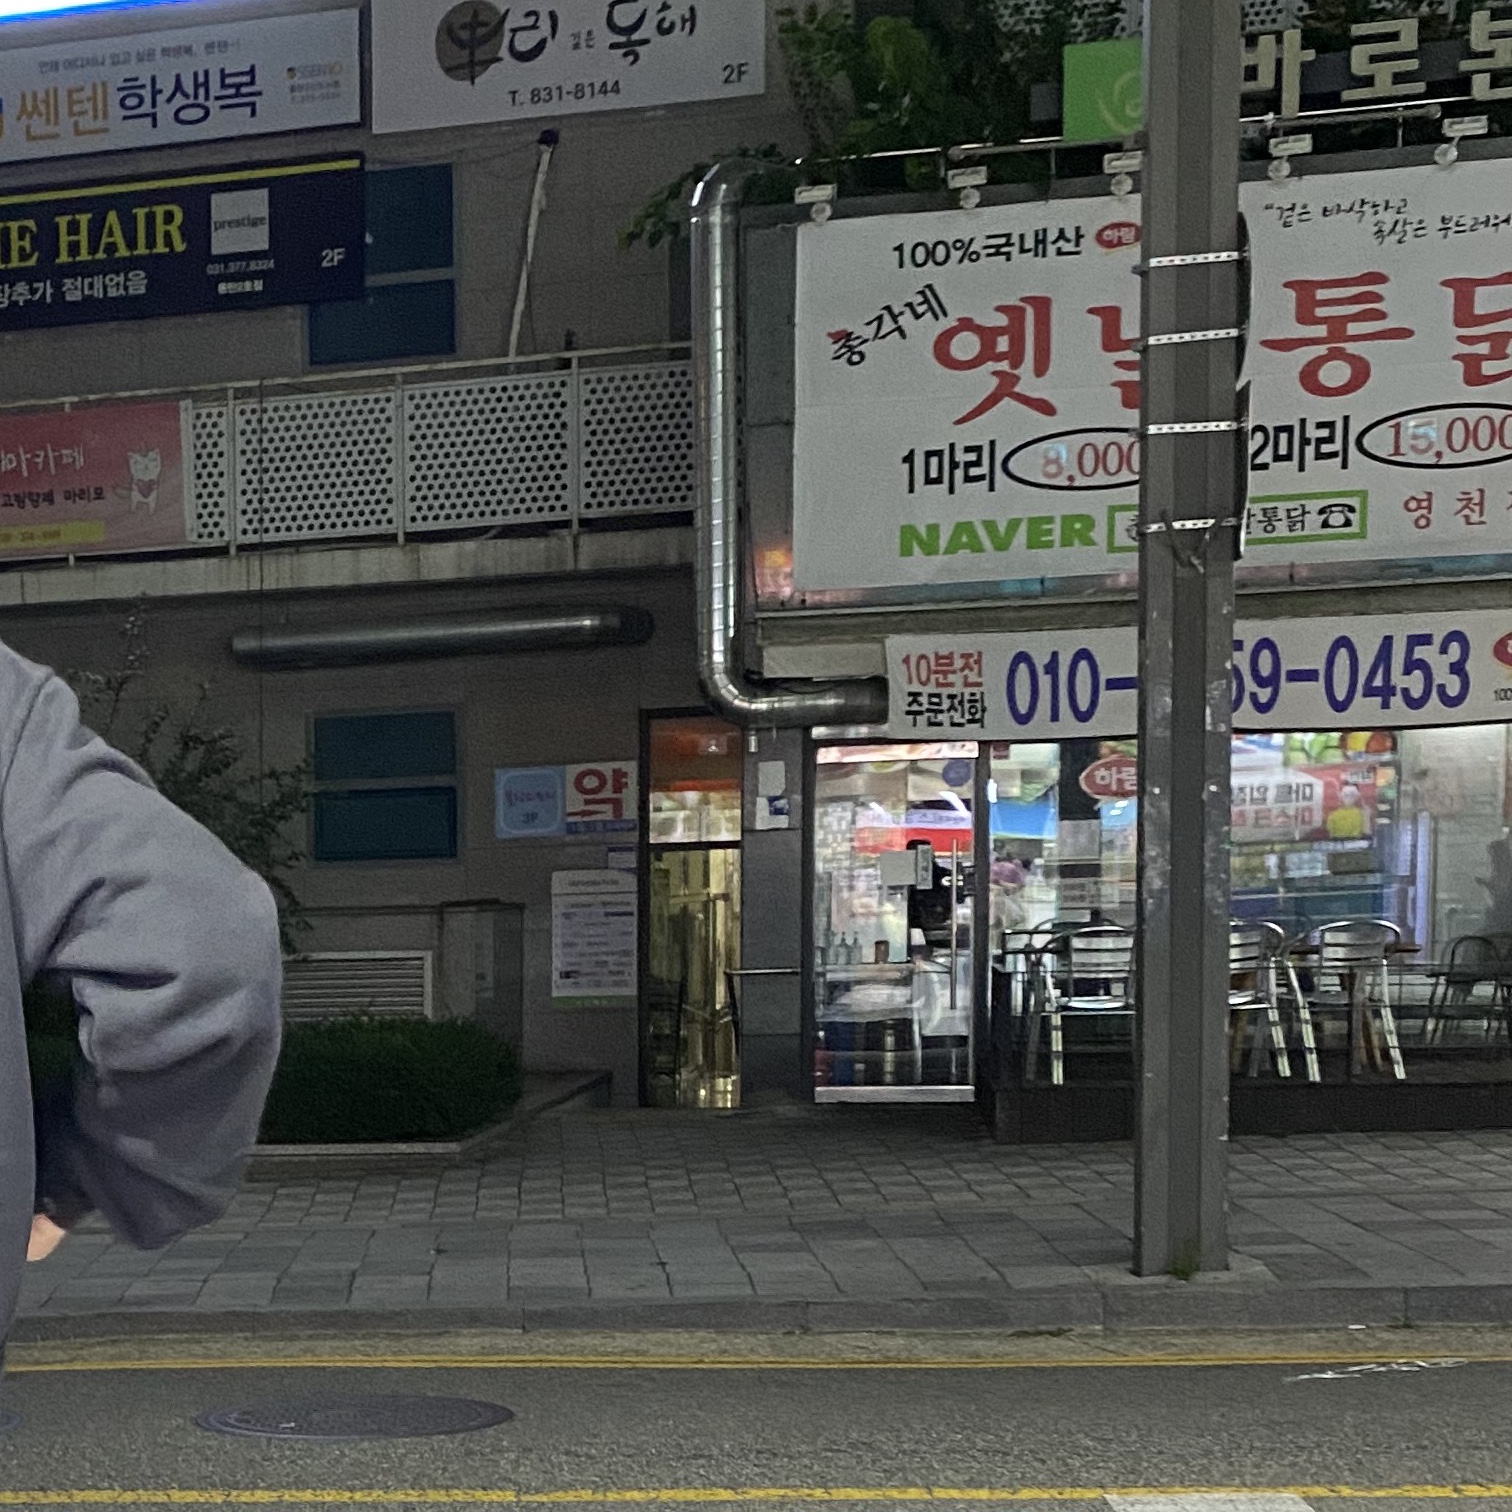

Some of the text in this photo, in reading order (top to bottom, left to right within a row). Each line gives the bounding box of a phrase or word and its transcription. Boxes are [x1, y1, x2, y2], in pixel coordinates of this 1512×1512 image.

[530, 80, 621, 106] 831-8144
[723, 62, 750, 85] 2F
[55, 203, 187, 264] HAIR
[213, 213, 267, 232] prestige
[321, 247, 346, 268] 2F
[892, 225, 1085, 269] 100%국내산
[61, 270, 148, 302] 절대없음
[1250, 414, 1350, 473] 2마리
[902, 439, 996, 495] 1마리
[63, 486, 106, 505] 마리모
[1403, 477, 1512, 530] 영천
[900, 514, 1096, 557] NAVER
[902, 650, 983, 689] 10분전
[905, 690, 987, 729] 주문전화
[574, 768, 630, 820] 약
